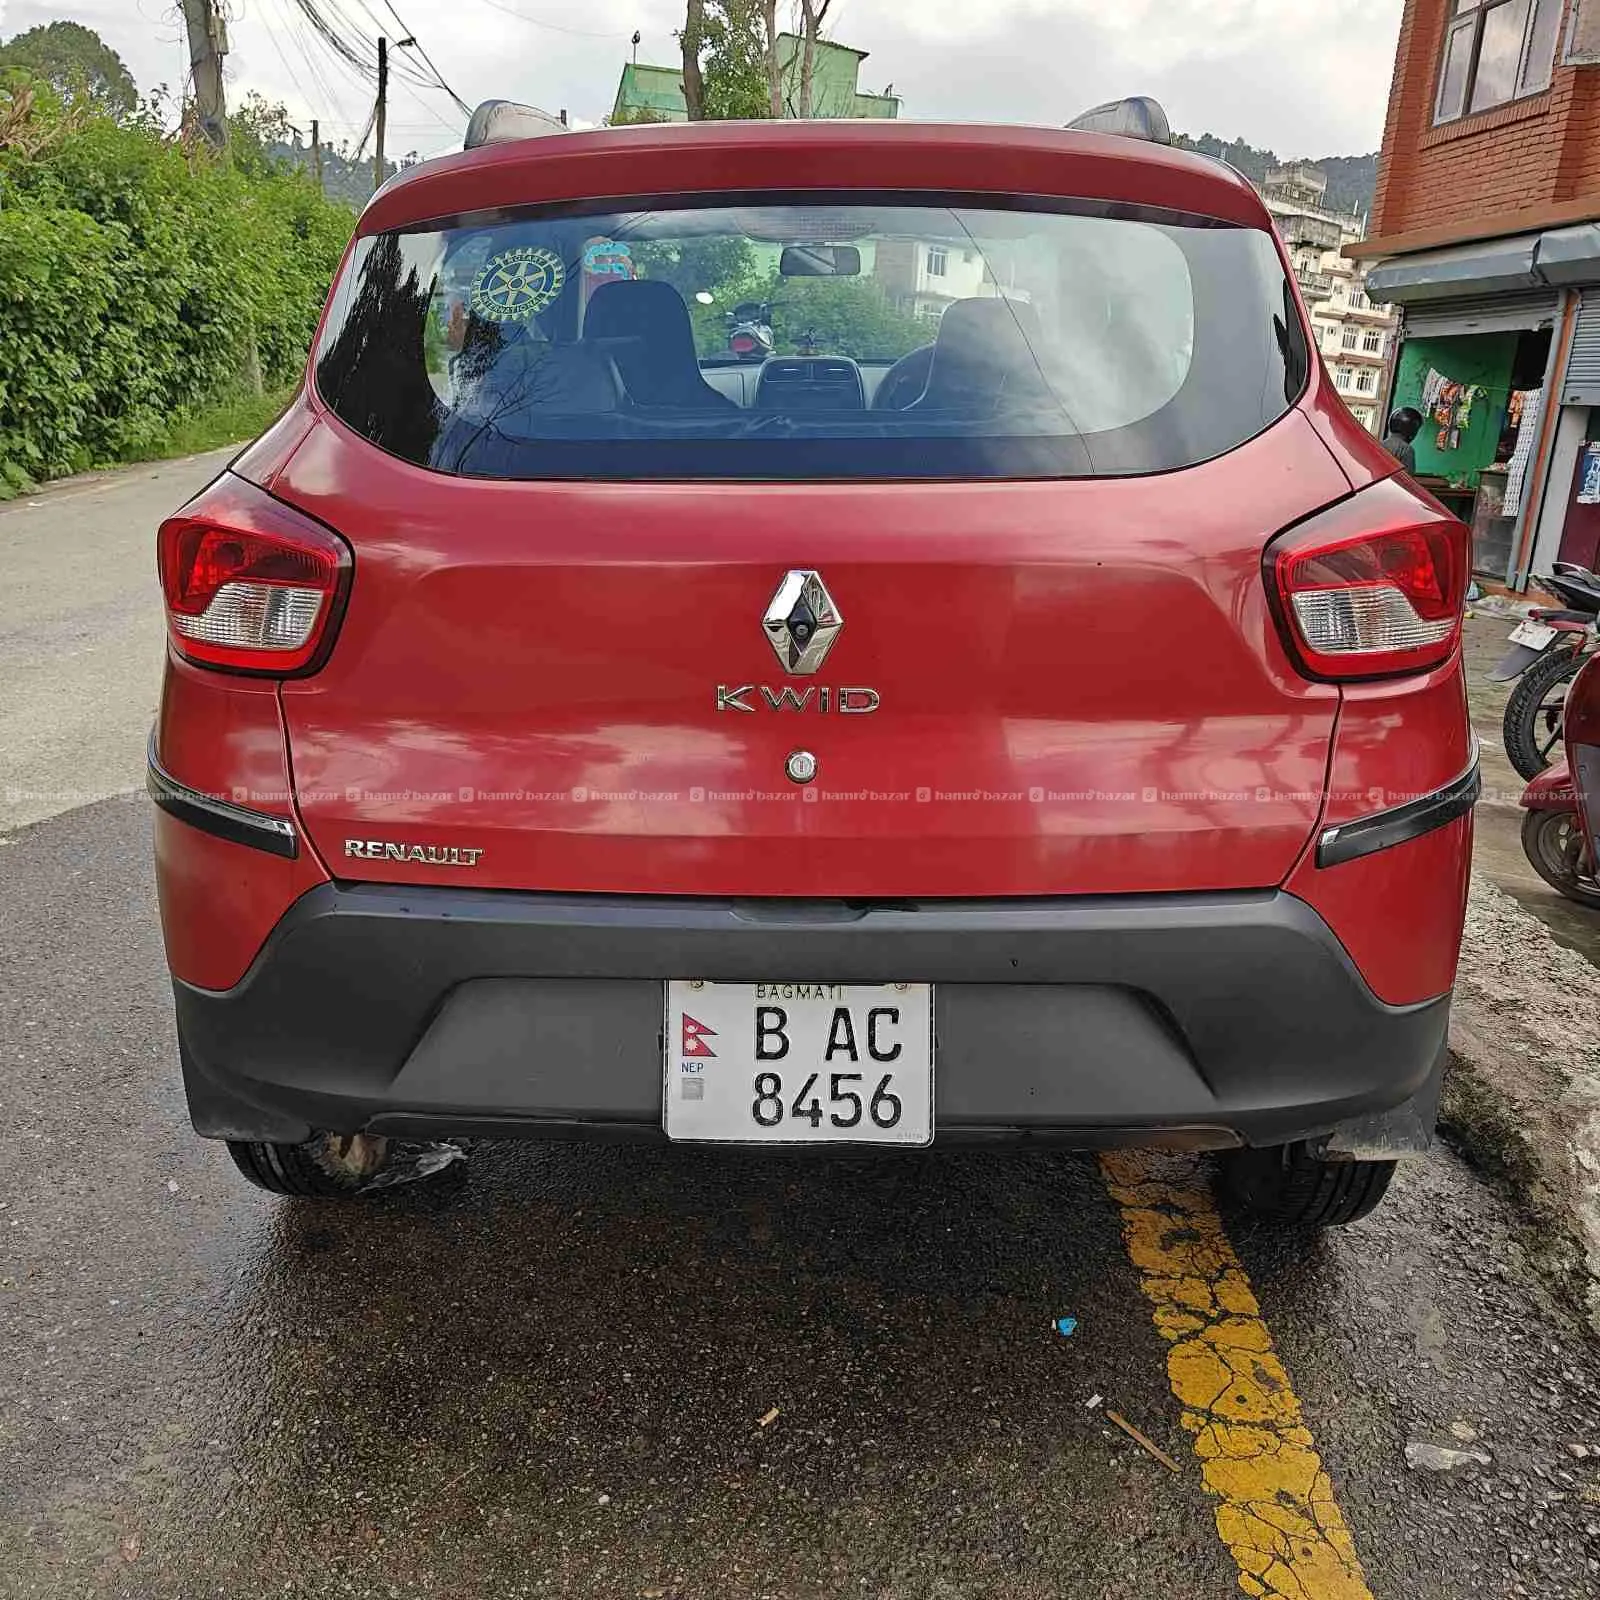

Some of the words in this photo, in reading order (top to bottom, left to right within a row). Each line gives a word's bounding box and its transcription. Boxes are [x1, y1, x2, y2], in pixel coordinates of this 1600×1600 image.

[716, 684, 880, 713] KWID
[345, 840, 483, 866] RENAULT
[757, 984, 843, 1000] BAGMATI
[756, 1006, 790, 1060] B
[825, 1007, 901, 1061] AC
[681, 1062, 704, 1073] NEP
[752, 1072, 902, 1128] 8456
